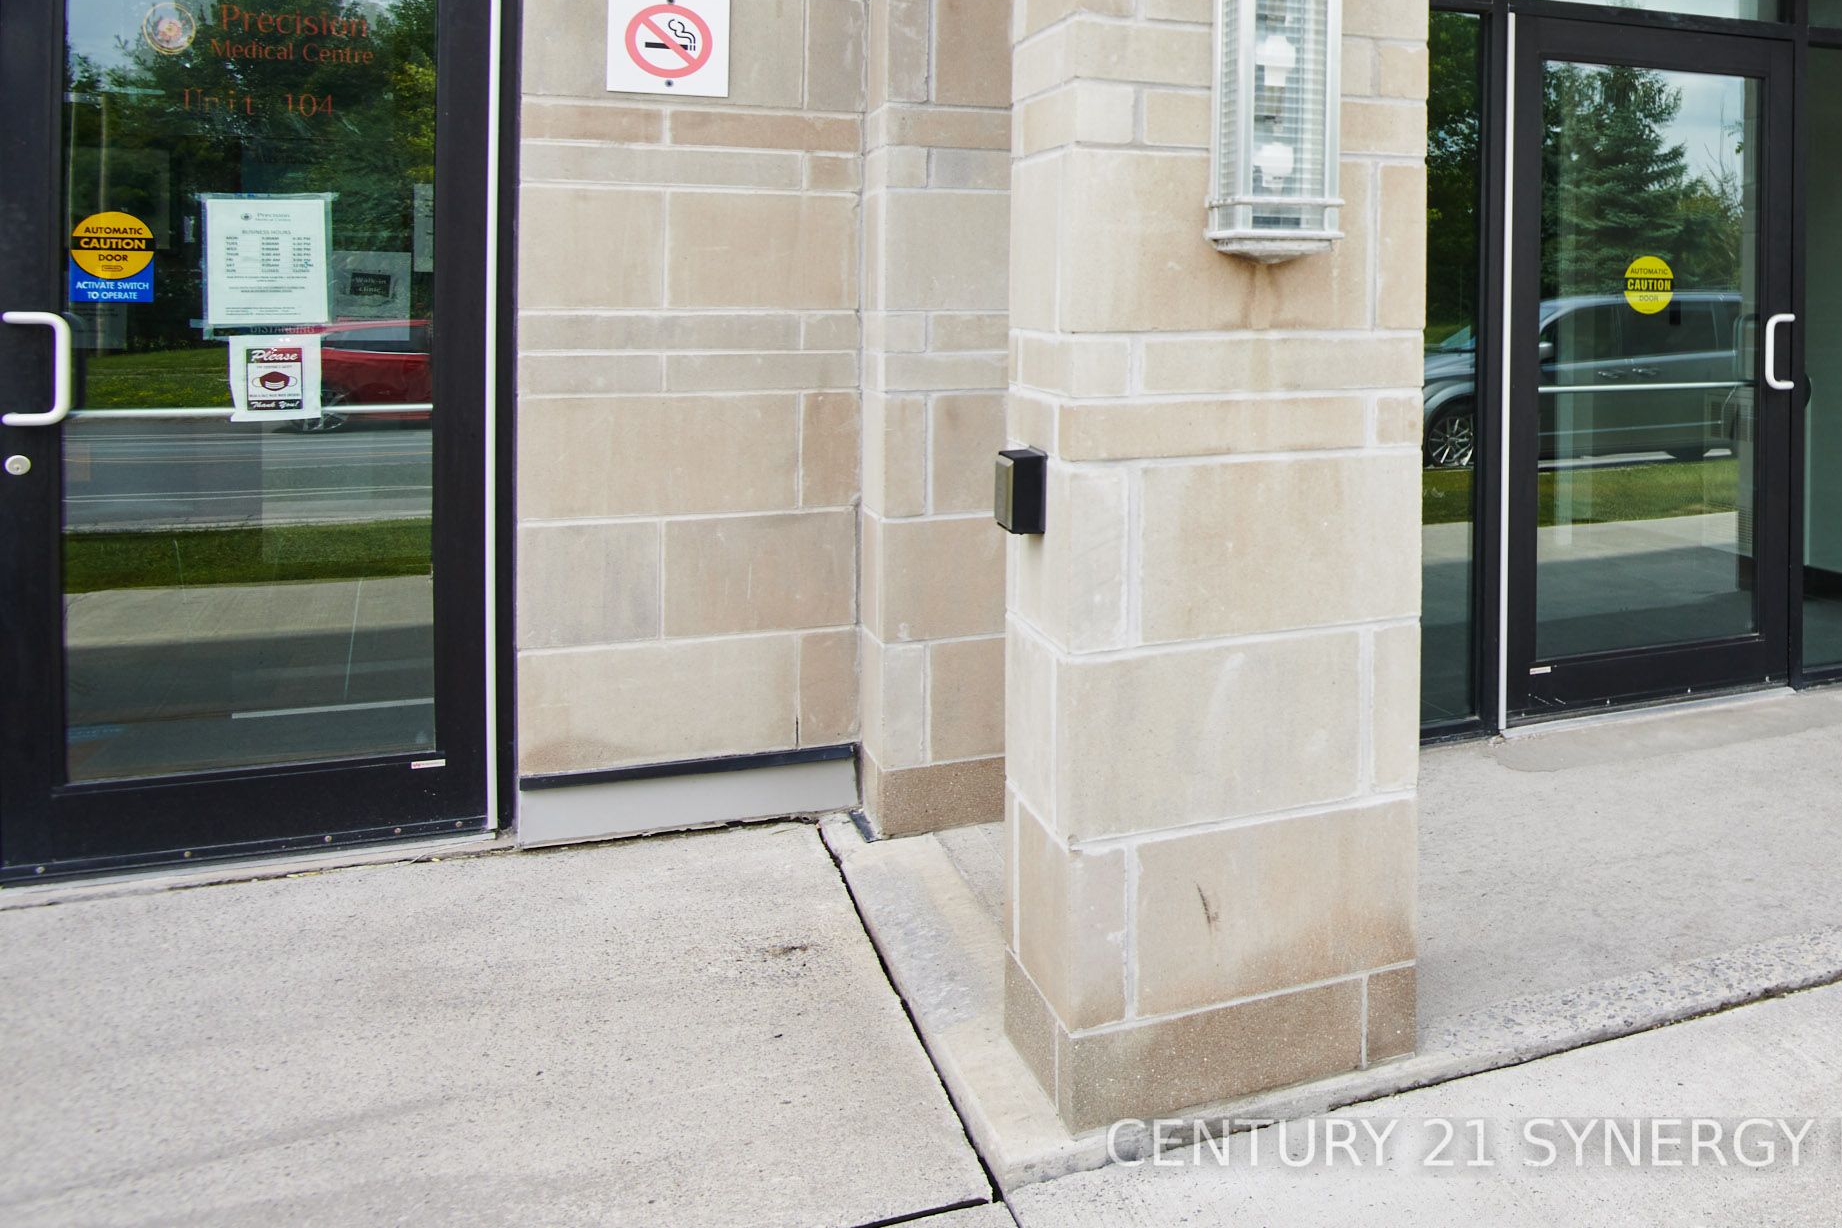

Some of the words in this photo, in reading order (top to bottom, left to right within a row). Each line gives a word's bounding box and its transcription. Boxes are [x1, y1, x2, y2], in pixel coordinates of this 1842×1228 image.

[218, 3, 368, 38] Precision
[209, 38, 294, 61] Medical
[302, 42, 375, 65] Centre
[182, 87, 256, 116] Unit
[285, 92, 334, 118] 104
[84, 226, 144, 235] AUTOMATIC
[80, 238, 146, 250] CAUTION
[98, 254, 129, 262] DOOR
[1630, 267, 1668, 276] AUTOMATIC
[75, 281, 115, 290] ACTIVATE
[117, 282, 150, 290] SWITCH
[1627, 278, 1672, 291] CAUTION
[87, 291, 99, 300] TO
[101, 291, 139, 300] OPERATE
[1639, 294, 1660, 302] DOOR
[250, 349, 299, 362] Please
[250, 400, 276, 409] Thank
